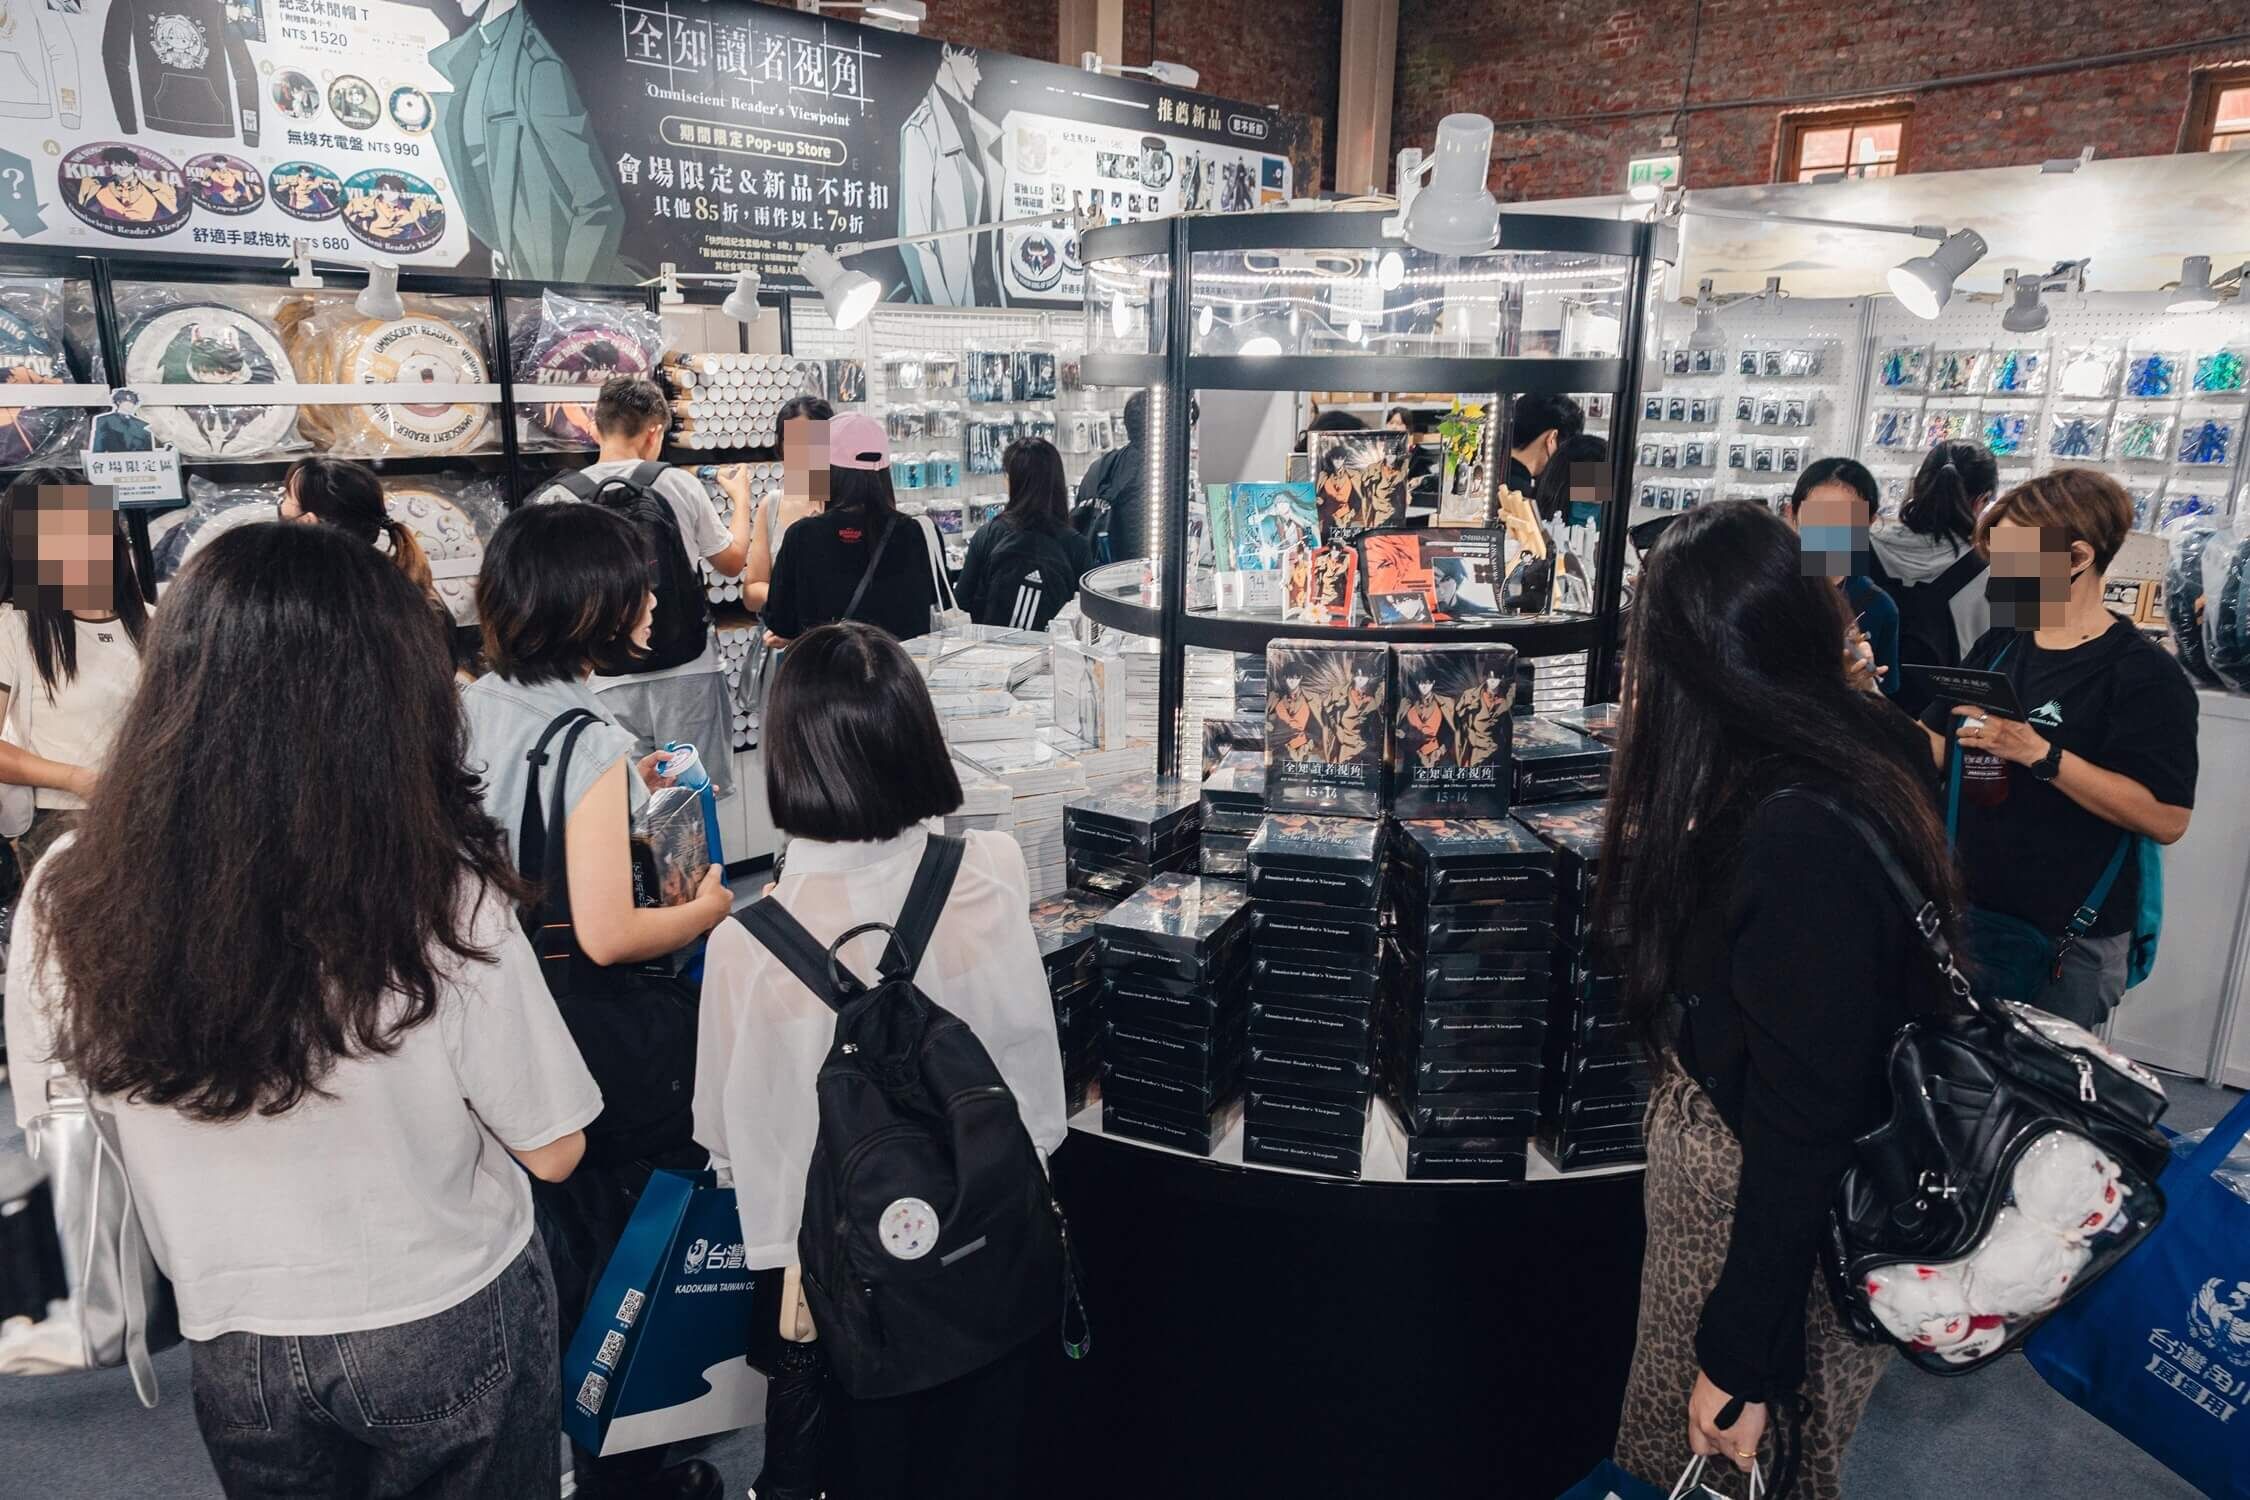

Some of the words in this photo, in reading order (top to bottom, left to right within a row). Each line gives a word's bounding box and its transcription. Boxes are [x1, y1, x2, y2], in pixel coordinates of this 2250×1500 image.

[311, 30, 348, 47] 1520
[630, 13, 858, 96] 全知讀者視角
[646, 82, 726, 108] Omniscient
[731, 96, 785, 118] Reader's
[790, 105, 851, 127] Viewpoint
[1157, 96, 1221, 131] 推薦新品
[287, 130, 364, 152] 無線充電盤
[394, 142, 420, 157] 990
[679, 123, 743, 150] 期間限定
[746, 134, 794, 157] Pop-up
[796, 142, 832, 159] Store
[616, 153, 889, 210] 會場限定&新品不折扣
[192, 227, 291, 249] 舒適手感抱枕
[322, 237, 350, 251] 680
[0, 316, 27, 340] ING
[1285, 761, 1361, 776] 全知讀者視角
[1416, 767, 1493, 779] 全知讀者視角
[705, 1242, 749, 1270] 台灣
[674, 1282, 718, 1294] KADOKAWA
[719, 1282, 745, 1292] TAIWAN
